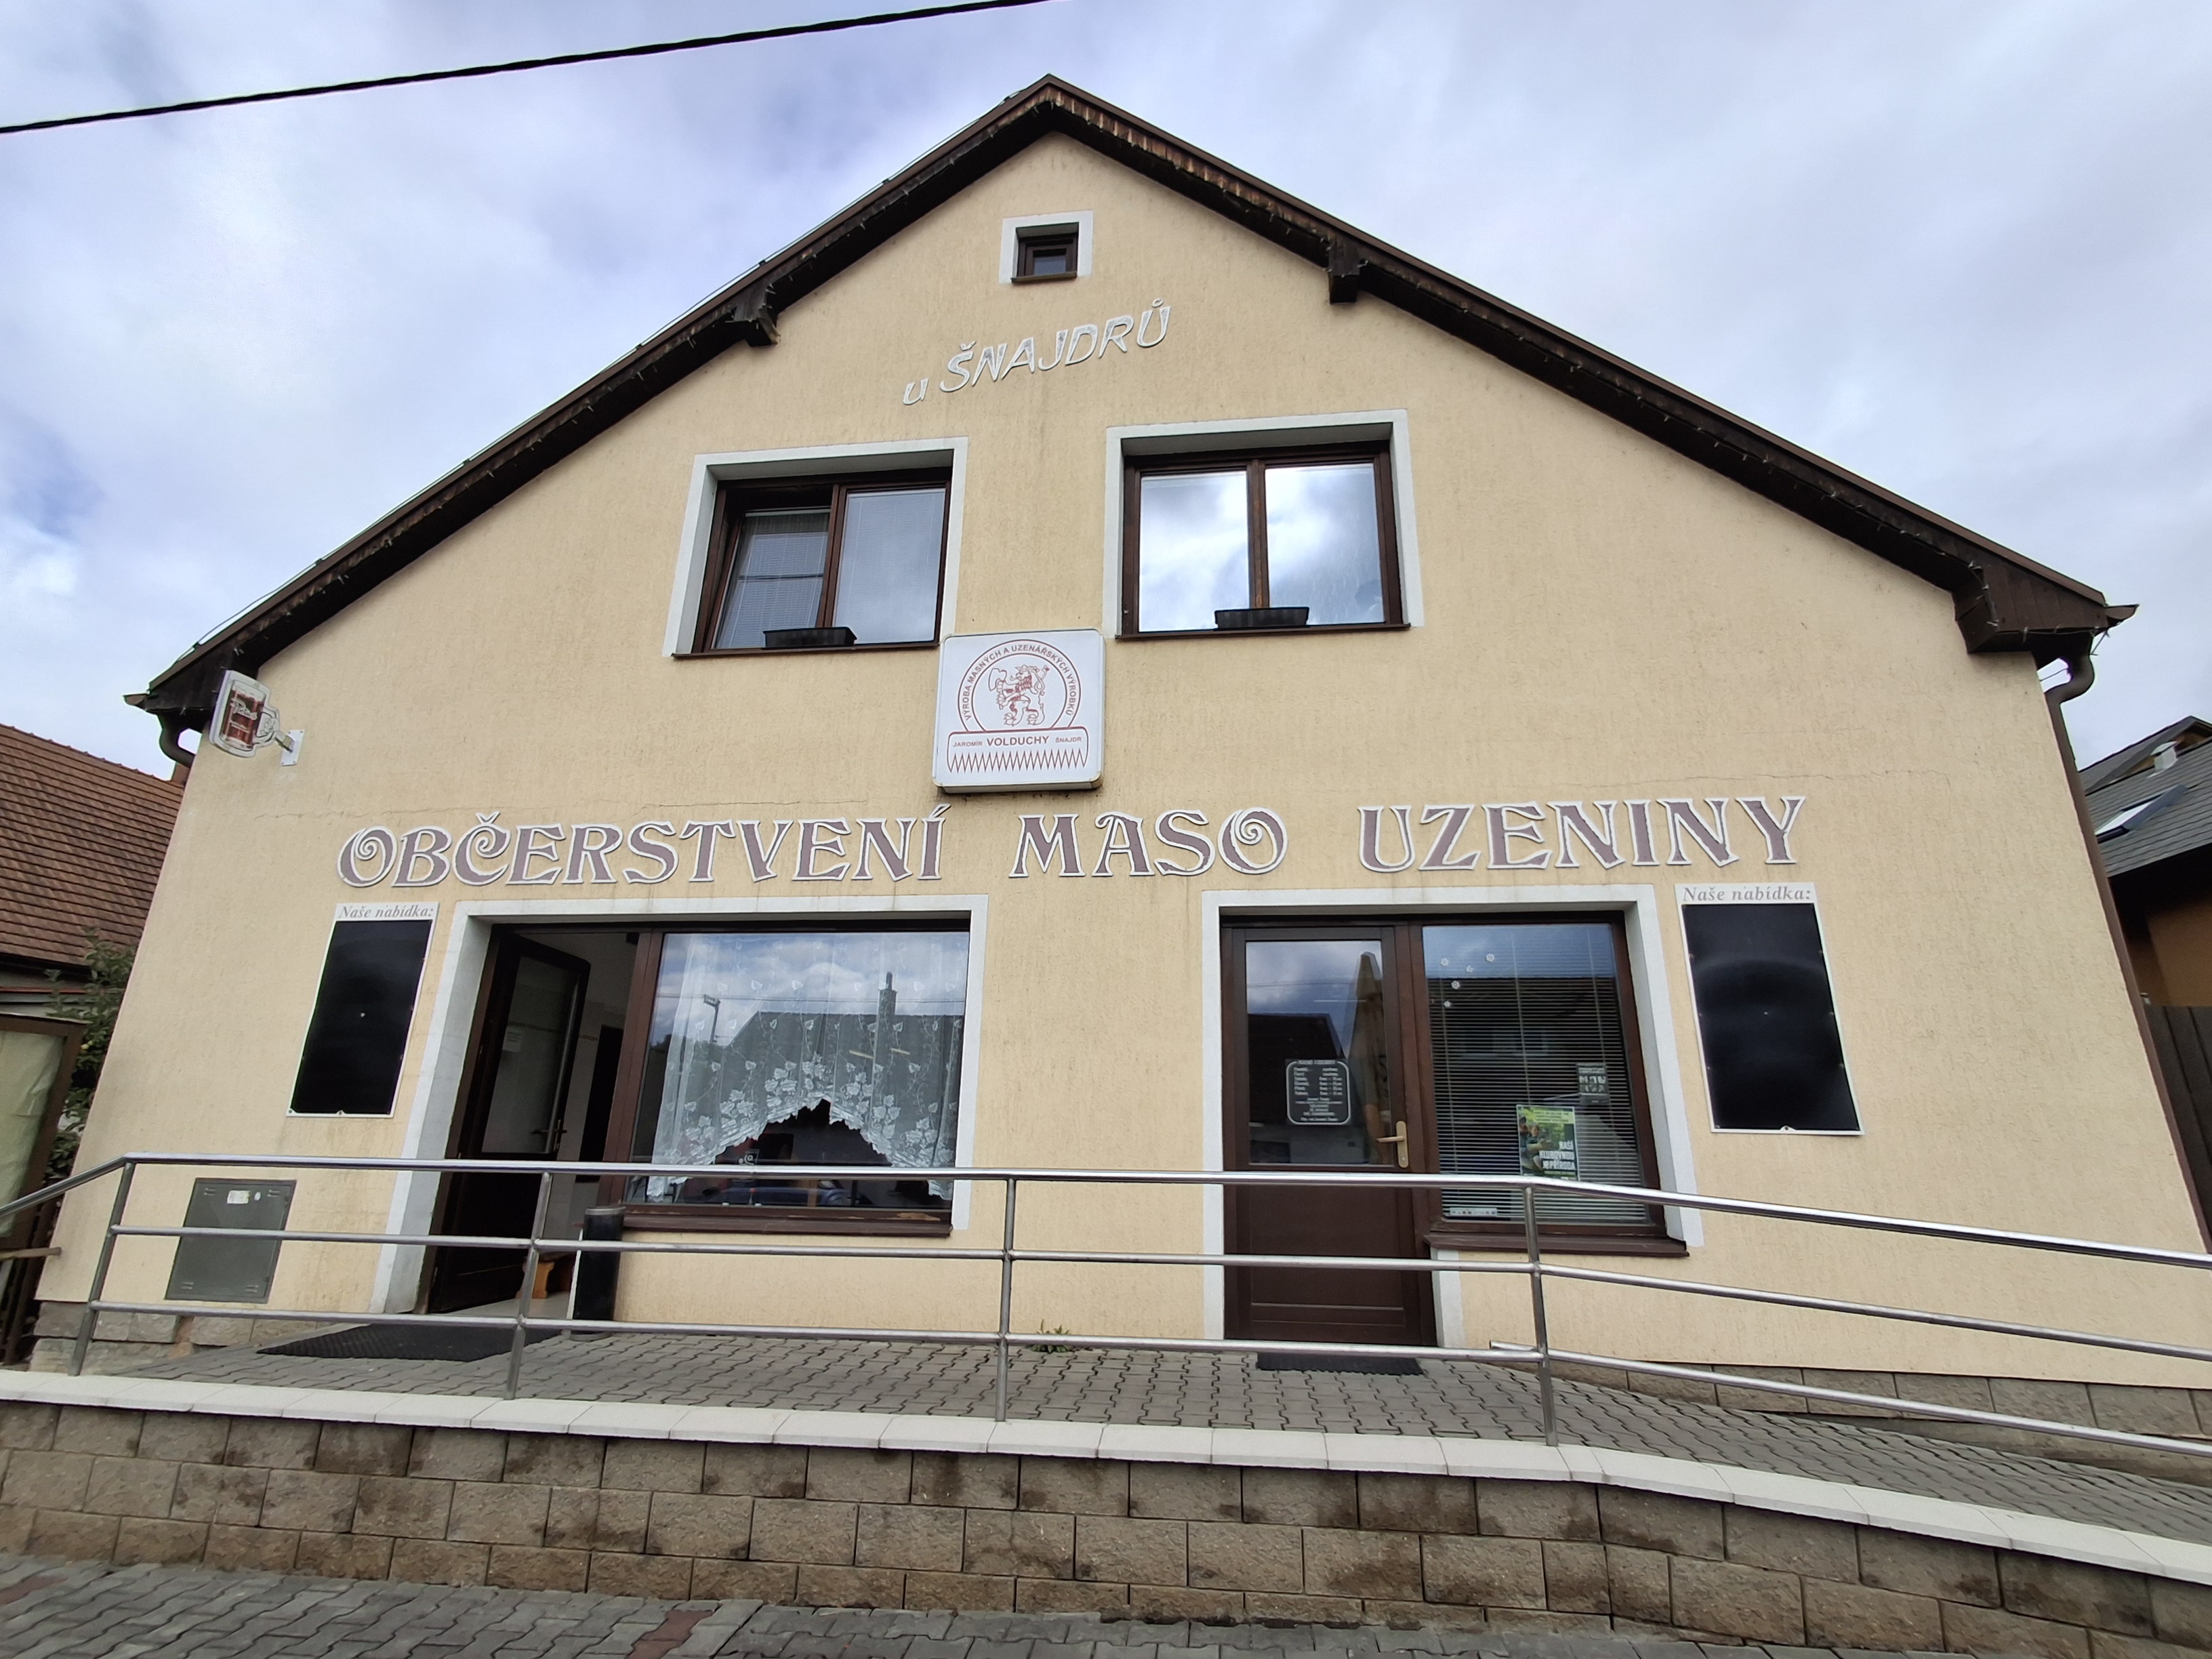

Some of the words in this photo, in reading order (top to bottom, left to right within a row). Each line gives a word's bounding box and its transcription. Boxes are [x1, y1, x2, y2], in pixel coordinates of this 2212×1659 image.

[902, 377, 929, 406] u
[939, 298, 1172, 393] ŠNAJDRŮ
[961, 684, 972, 721] VÝROBA
[968, 651, 1002, 687] MASNÝCH
[1011, 644, 1069, 674] UZENÁŘSKÝCH
[1065, 672, 1078, 716] VÝROBKŮ
[987, 735, 1050, 747] VOLDUCHY
[337, 804, 951, 888] OBČERSTVENÍ
[1008, 807, 1288, 878] MASO
[1357, 796, 1807, 874] UZENINY
[339, 905, 371, 919] Naše
[375, 905, 434, 918] nabídka:
[1683, 886, 1725, 901] Naše
[1732, 885, 1811, 901] nabídka:
